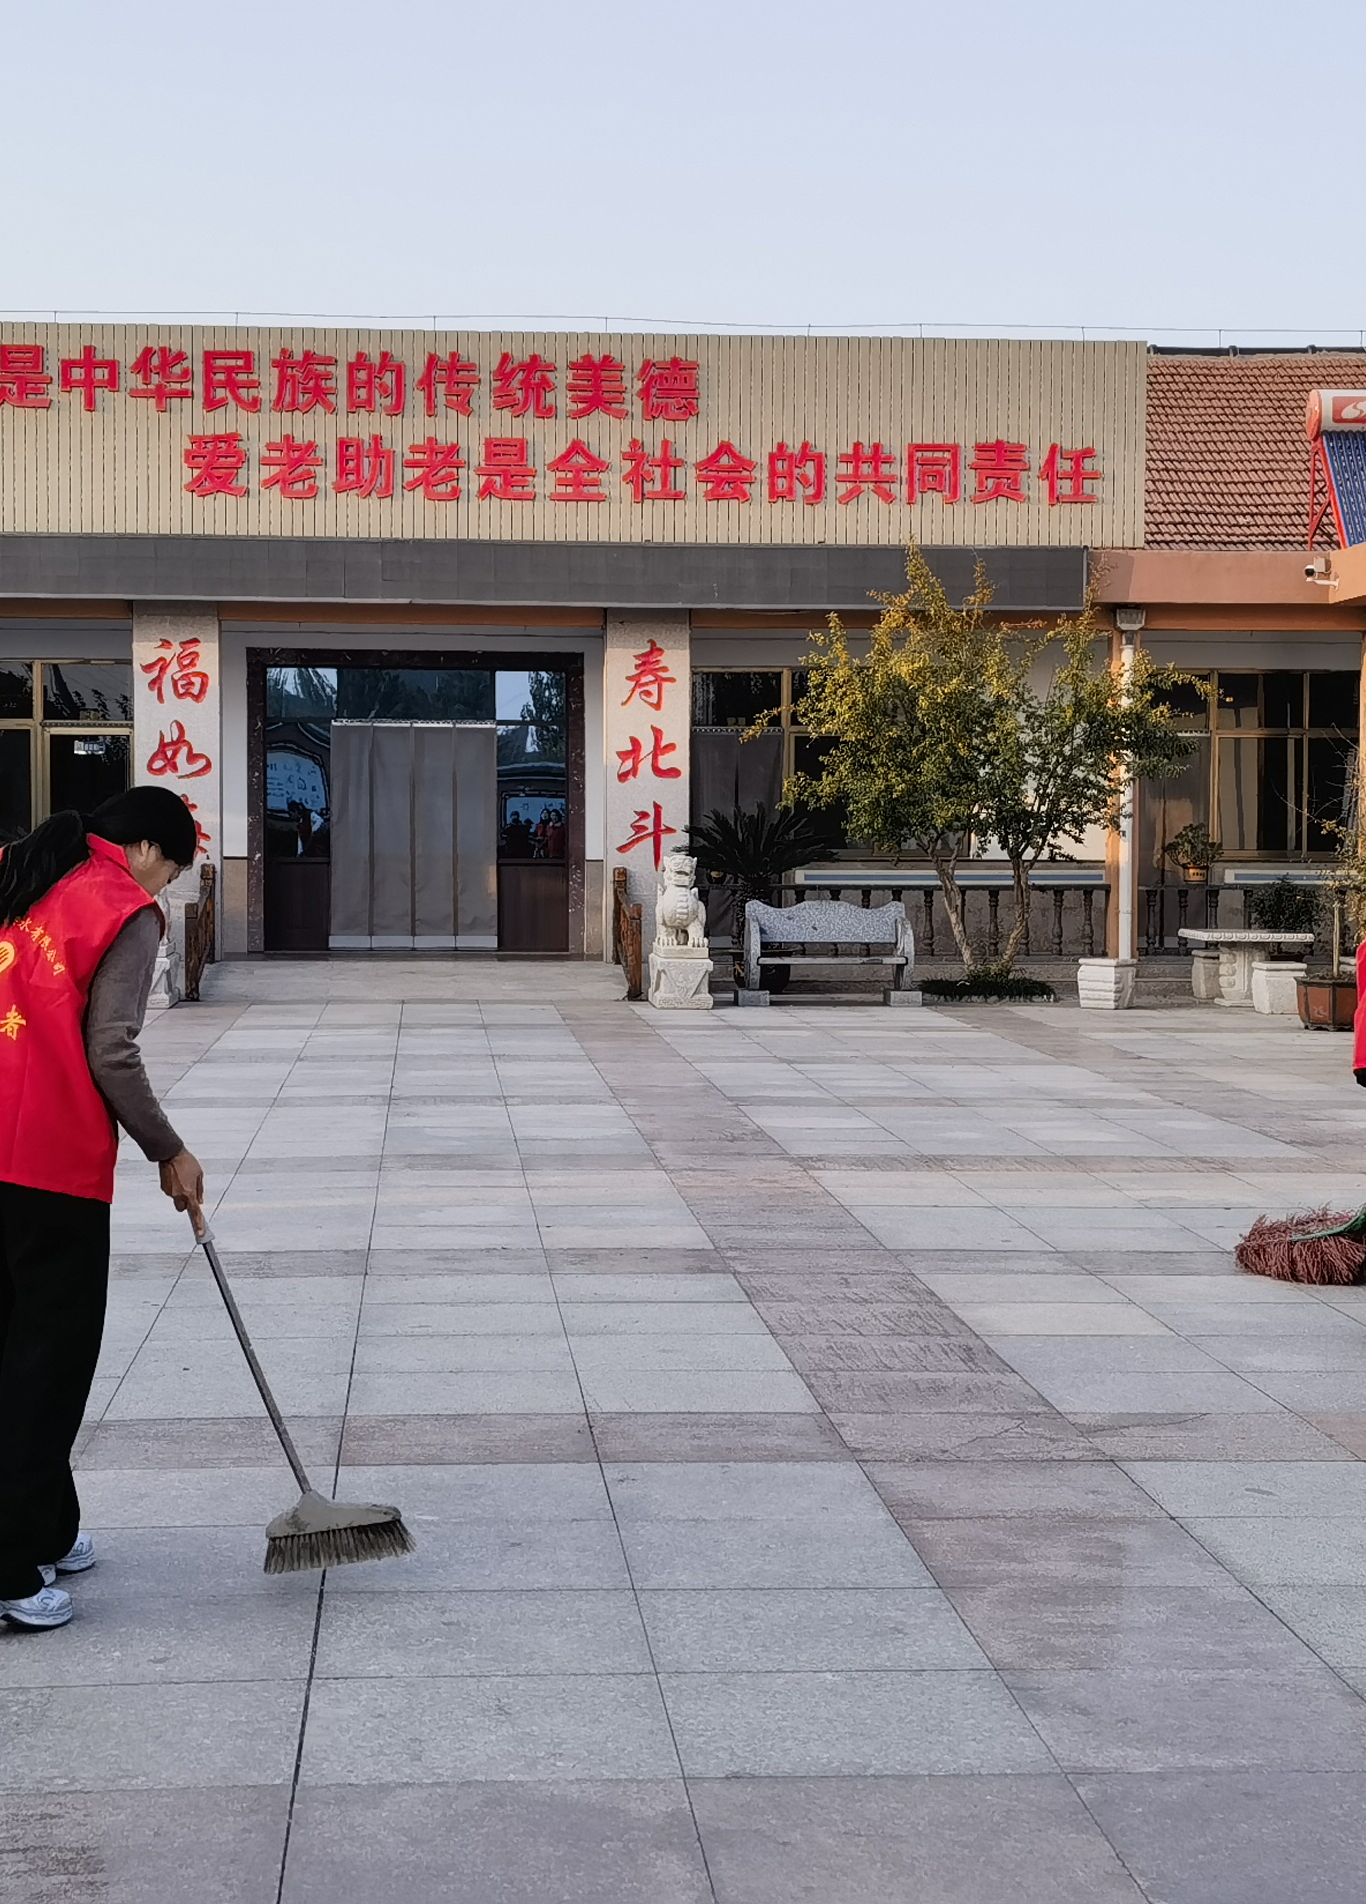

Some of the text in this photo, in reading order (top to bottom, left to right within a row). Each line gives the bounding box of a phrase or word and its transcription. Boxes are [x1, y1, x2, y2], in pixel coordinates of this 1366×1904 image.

[183, 432, 1103, 505] 爱老助老是全社会的共同责任
[140, 637, 212, 860] 福如
